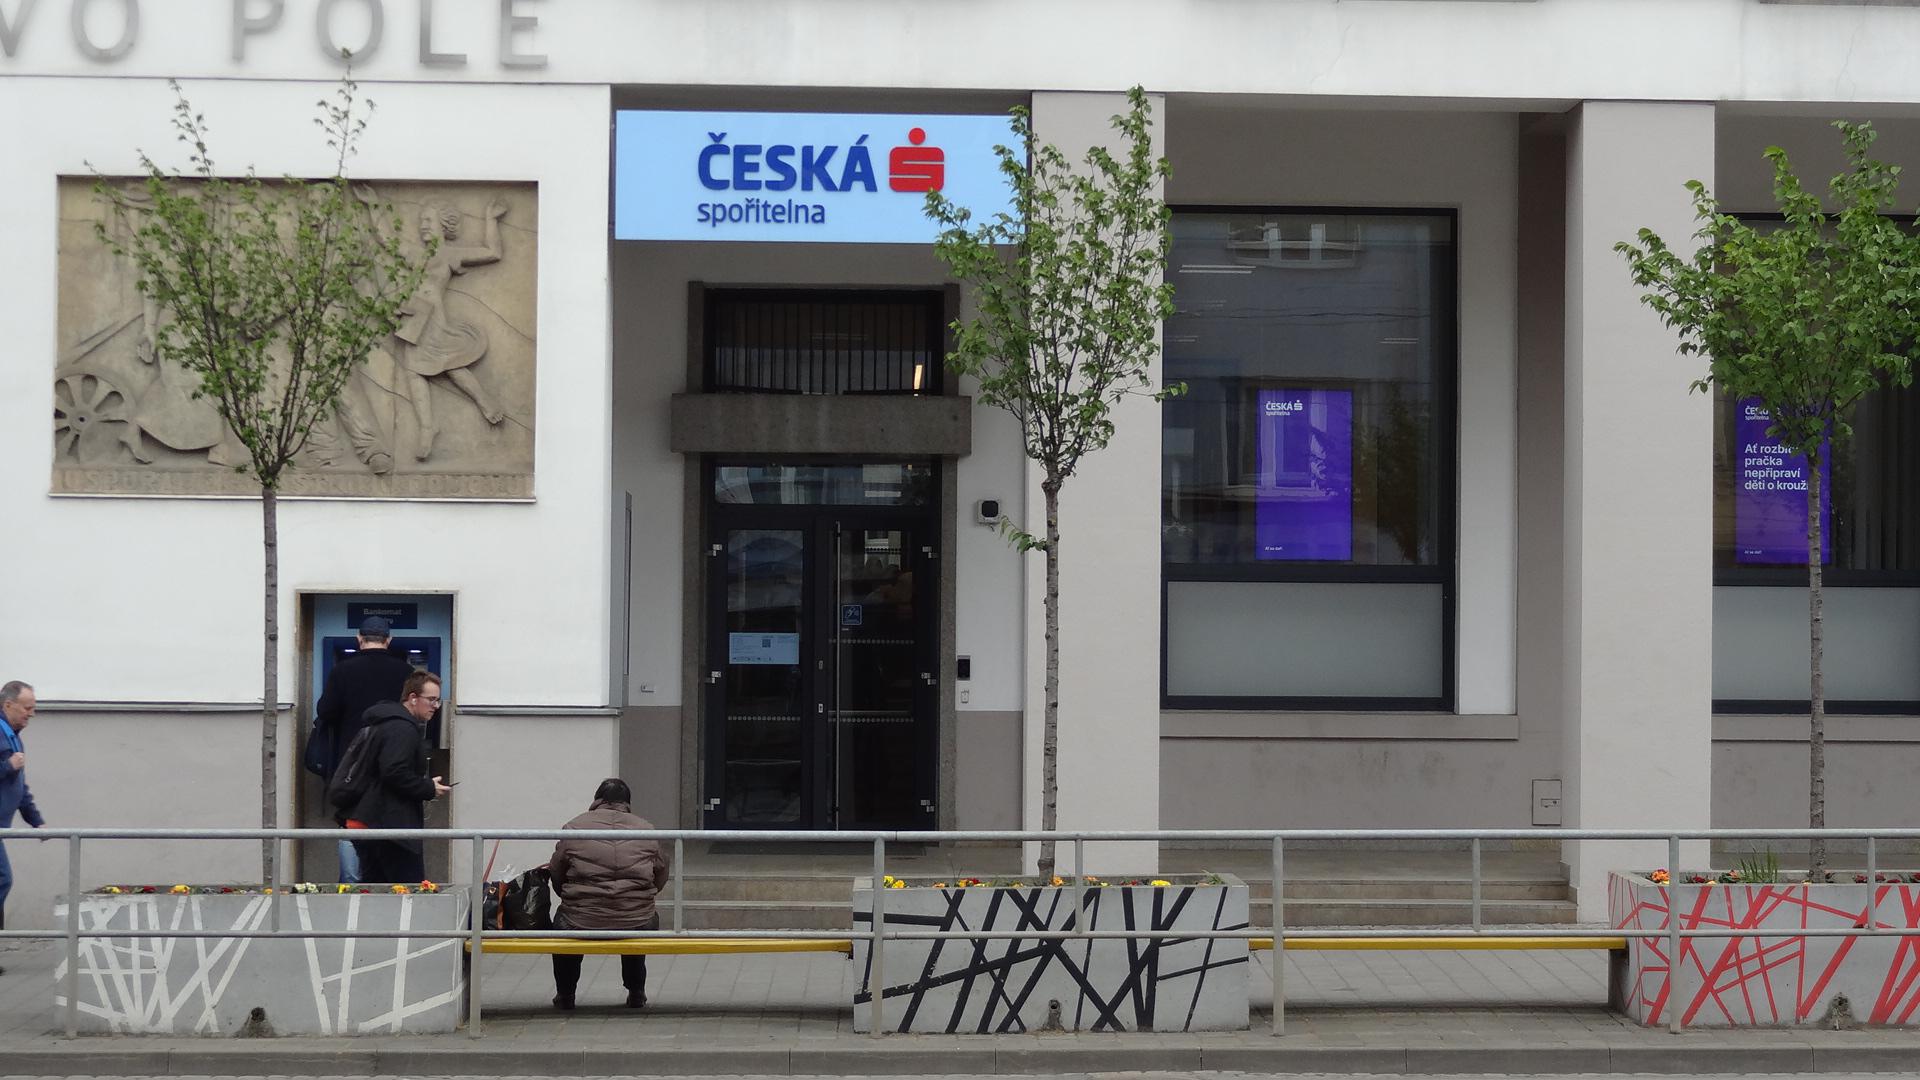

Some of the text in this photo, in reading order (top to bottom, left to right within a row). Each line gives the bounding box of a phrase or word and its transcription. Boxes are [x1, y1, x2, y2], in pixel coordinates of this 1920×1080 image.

[231, 0, 549, 69] POLE
[697, 132, 878, 193] ČESKÁ
[697, 199, 826, 228] spořitelna
[1265, 400, 1294, 411] ČESKÁ
[1744, 443, 1758, 454] Ať
[1744, 455, 1783, 468] pračka
[1744, 467, 1801, 480] nepřipraví
[1744, 479, 1765, 490] děti
[1767, 482, 1775, 490] o
